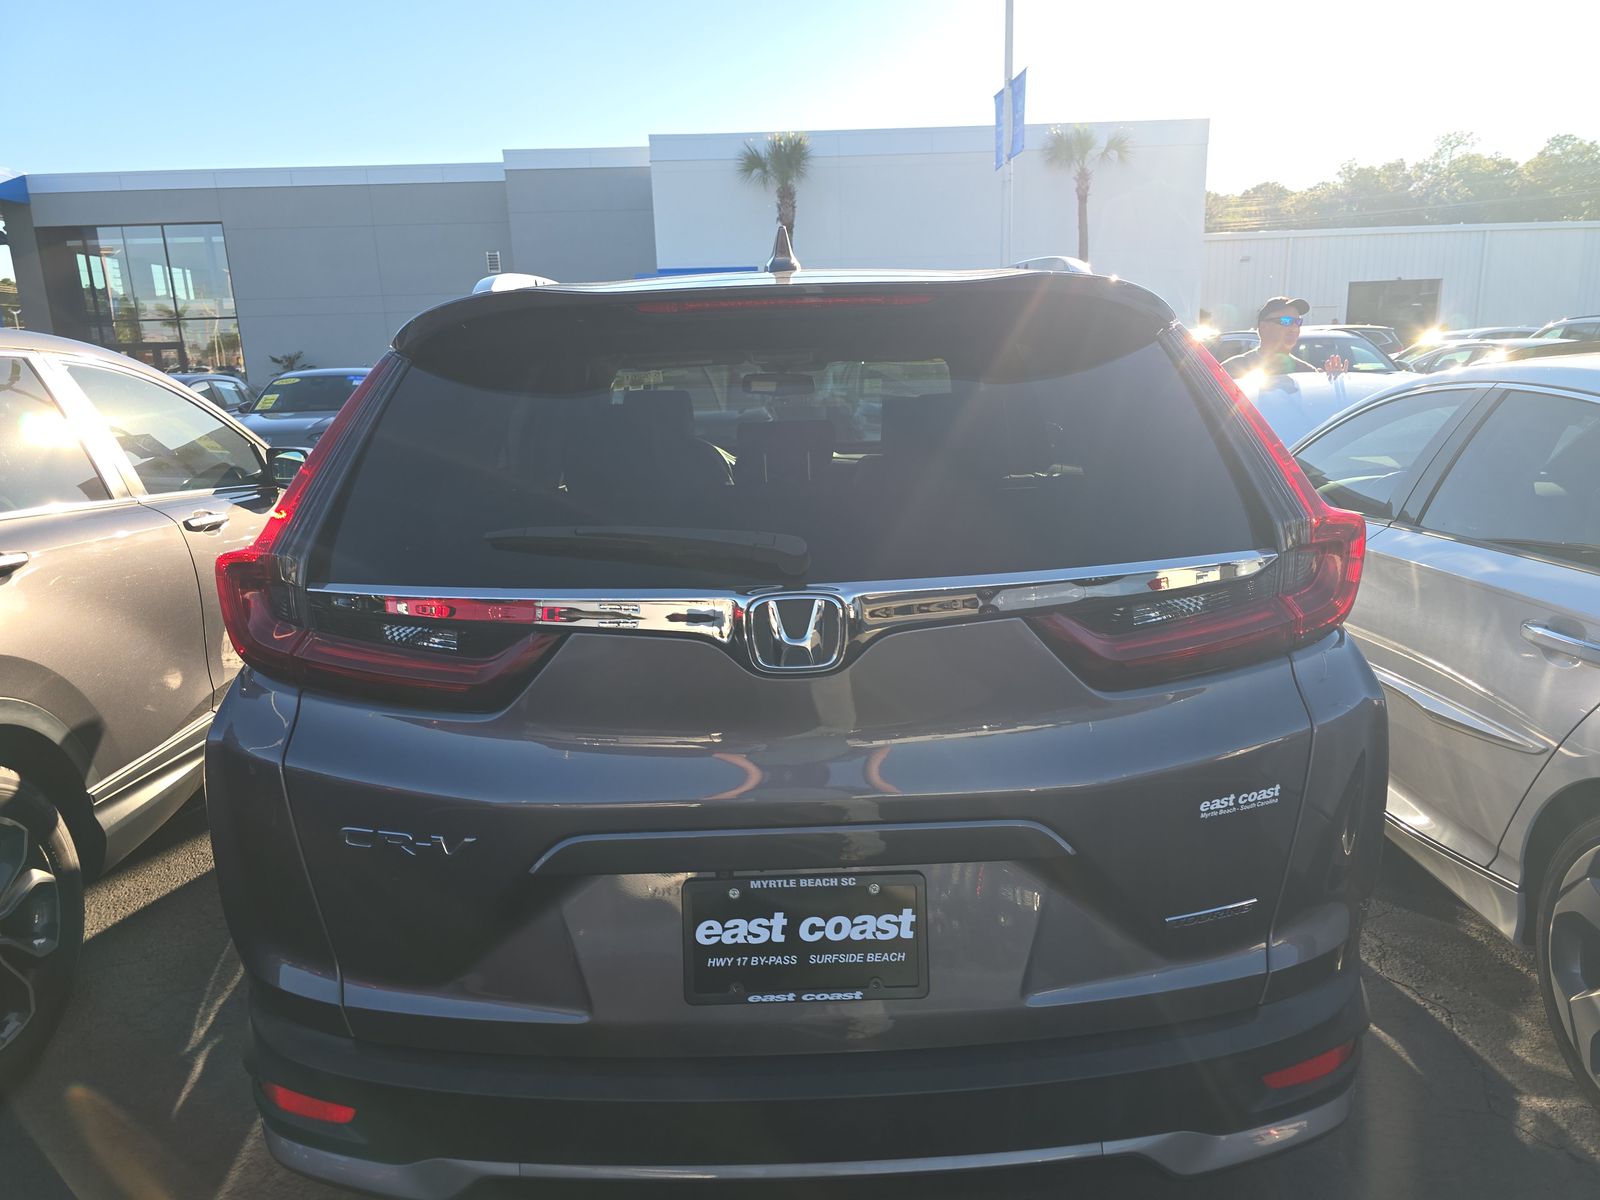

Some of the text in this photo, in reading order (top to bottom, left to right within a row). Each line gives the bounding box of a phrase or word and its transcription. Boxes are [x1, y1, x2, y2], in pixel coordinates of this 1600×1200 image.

[1199, 783, 1281, 812] east coast
[1200, 810, 1219, 819] Myrtle
[1218, 806, 1237, 816] Beach
[1239, 802, 1256, 811] South
[1256, 798, 1279, 808] Carolina
[341, 826, 477, 856] CR-V
[750, 877, 856, 889] MYRTLE BEACH SC
[695, 908, 917, 946] east coast
[707, 952, 906, 967] HWY 17 BY-PASS SURFSIDE BEACH
[747, 990, 864, 1003] east coast
